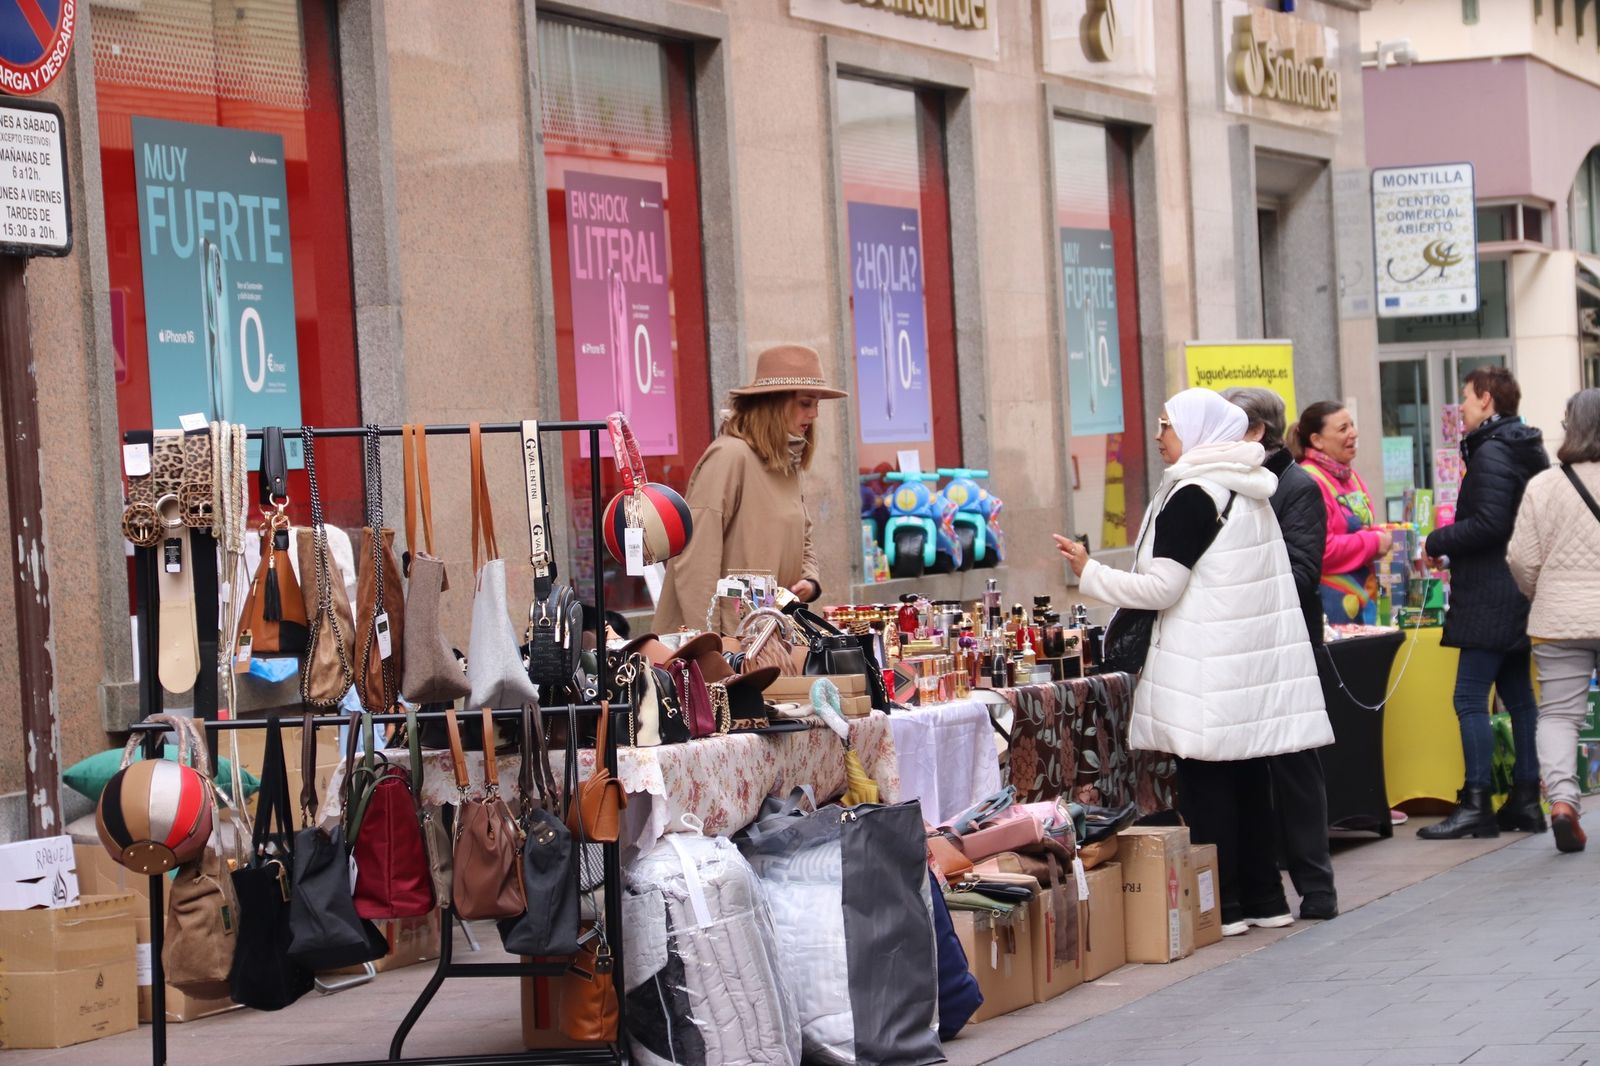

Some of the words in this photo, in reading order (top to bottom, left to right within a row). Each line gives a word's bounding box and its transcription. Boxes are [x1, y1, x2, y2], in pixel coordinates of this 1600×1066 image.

[31, 70, 39, 88] Y
[40, 0, 75, 83] DESCARG
[16, 117, 21, 129] A
[23, 115, 56, 133] SÁBADO
[12, 165, 17, 178] 6
[19, 169, 23, 179] a
[40, 152, 51, 166] DE
[143, 142, 188, 182] MUY
[1382, 170, 1464, 187] MONTILLA
[21, 188, 26, 201] A
[28, 189, 61, 204] VIERNES
[571, 190, 588, 219] EN
[589, 192, 629, 224] SHOCK
[1397, 194, 1450, 208] CENTRO
[6, 205, 38, 221] TARDES
[40, 209, 51, 221] DE
[146, 184, 284, 264] FUERTE
[1386, 208, 1462, 222] COMERCIAL
[3, 223, 28, 237] 15:30
[30, 228, 36, 237] a
[1396, 222, 1453, 234] ABIERTO
[573, 223, 663, 285] LITERAL
[856, 241, 918, 293] ¿HOLA?
[1063, 242, 1080, 265] MUY
[1065, 266, 1115, 309] FUERTE
[239, 306, 266, 393] 0
[634, 323, 652, 394] 0
[898, 329, 912, 390] 0
[528, 451, 537, 499] VALENTINI
[35, 843, 72, 870] RAQUEL
